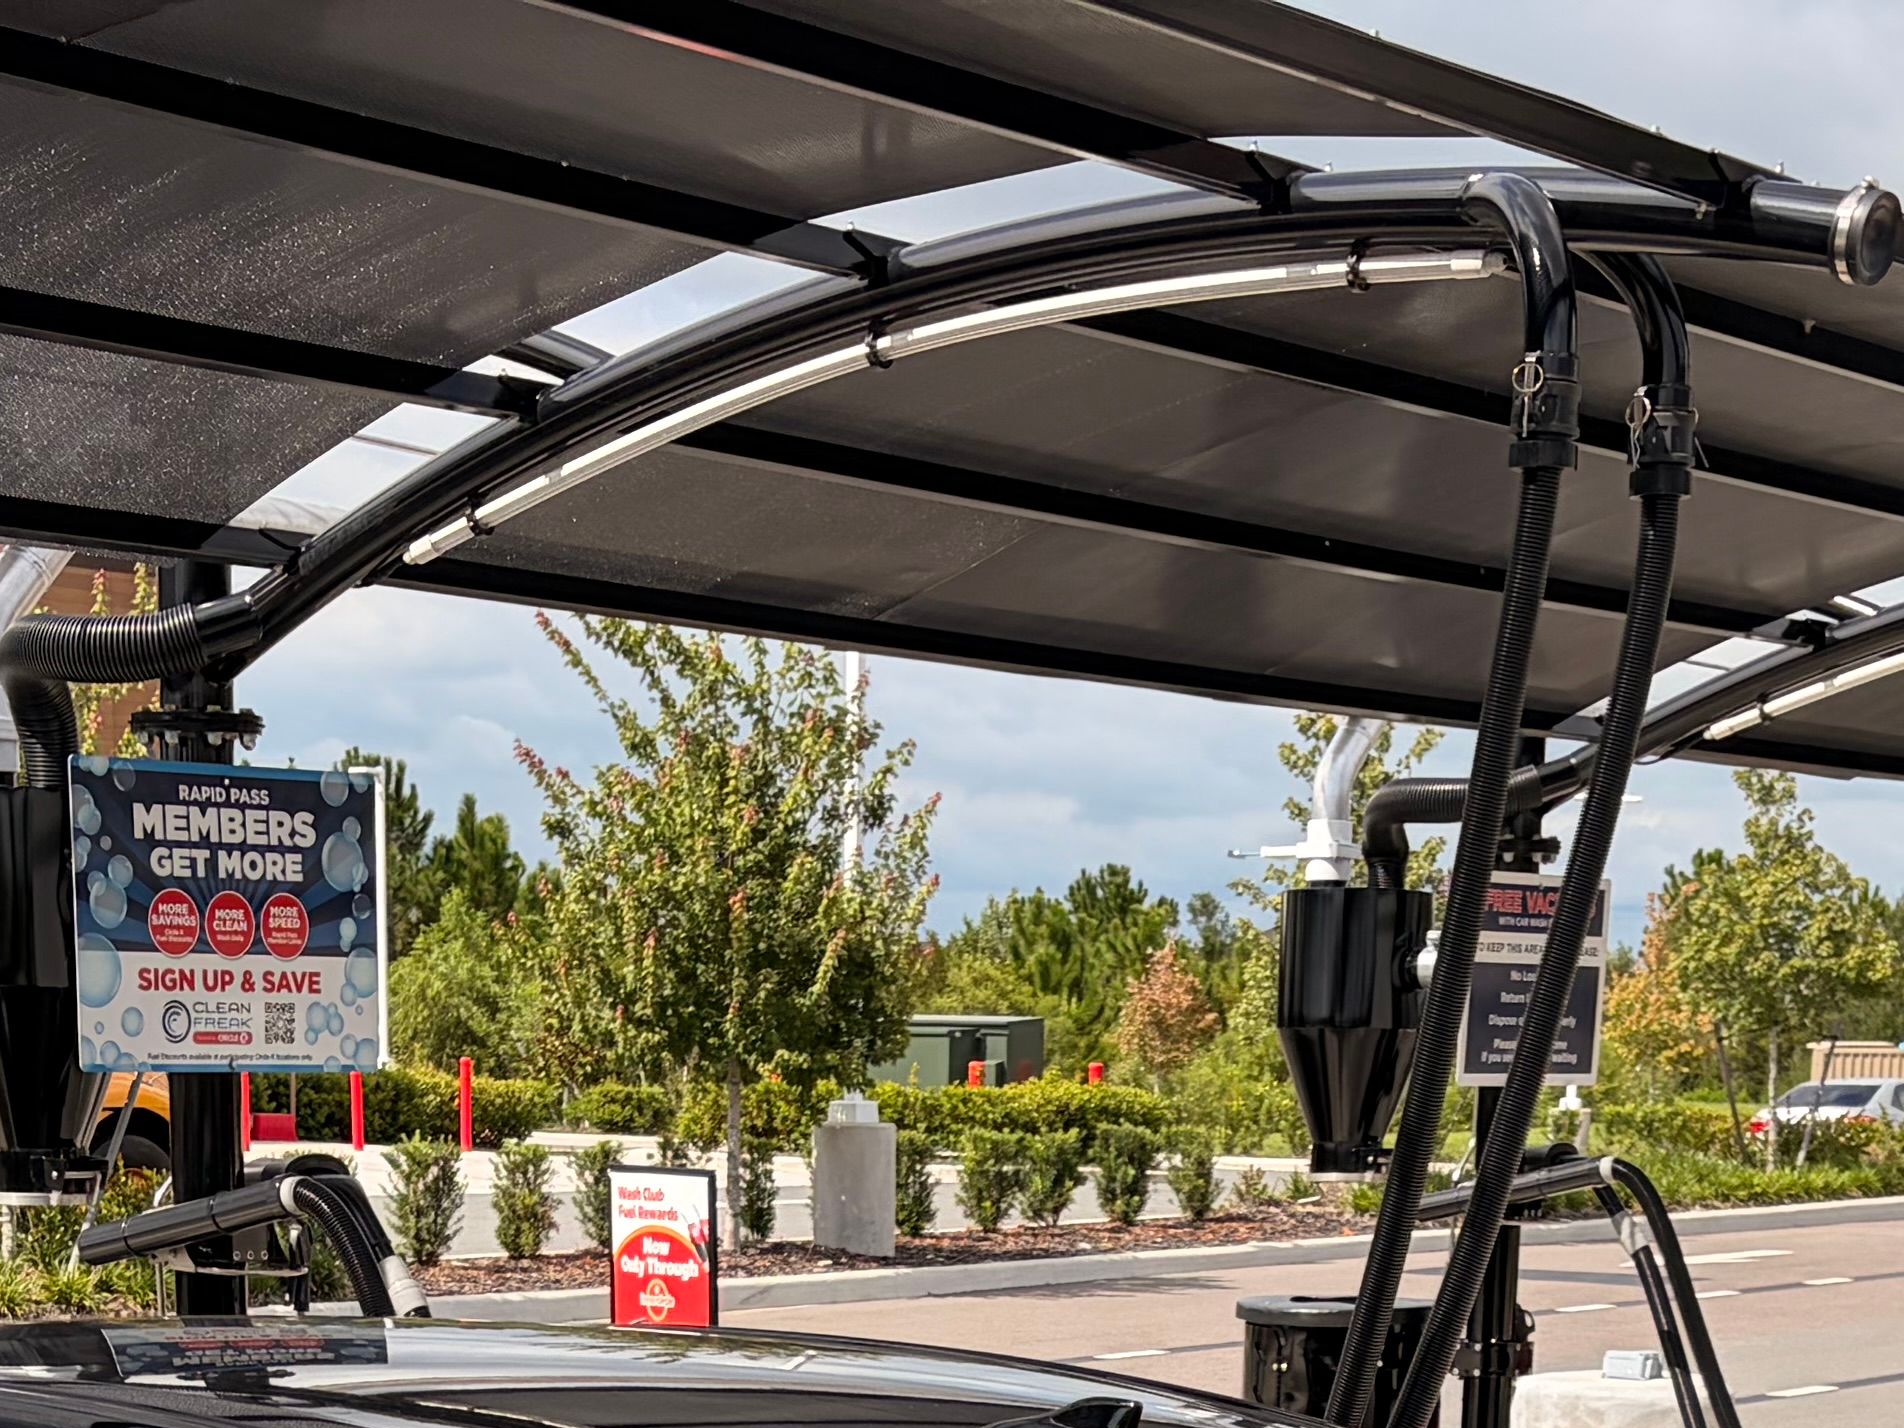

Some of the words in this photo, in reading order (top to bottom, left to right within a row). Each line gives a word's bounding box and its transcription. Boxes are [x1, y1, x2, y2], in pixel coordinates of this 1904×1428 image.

[179, 784, 227, 802] RAPID
[230, 788, 270, 806] PASS
[133, 803, 317, 848] MEMBERS
[150, 847, 211, 879] GET
[218, 850, 304, 882] MORE
[1485, 888, 1523, 913] FREE
[158, 903, 189, 915] MORE
[215, 909, 245, 921] MORE
[270, 906, 299, 918] MORE
[151, 914, 196, 927] SAVINGS
[213, 920, 247, 932] CLEAN
[269, 918, 300, 929] SPEED
[1487, 942, 1504, 952] KEEP
[1507, 943, 1523, 954] THIS
[138, 967, 195, 992] SIGN
[202, 969, 235, 993] UP
[240, 970, 256, 993] &
[262, 971, 322, 994] SAVE
[193, 1001, 251, 1014] CLEAN
[193, 1017, 253, 1030] FREAK
[618, 1186, 641, 1201] Wash
[643, 1188, 665, 1202] Club
[643, 1237, 671, 1256] Now
[621, 1255, 645, 1278] Only
[647, 1257, 699, 1281] Through
